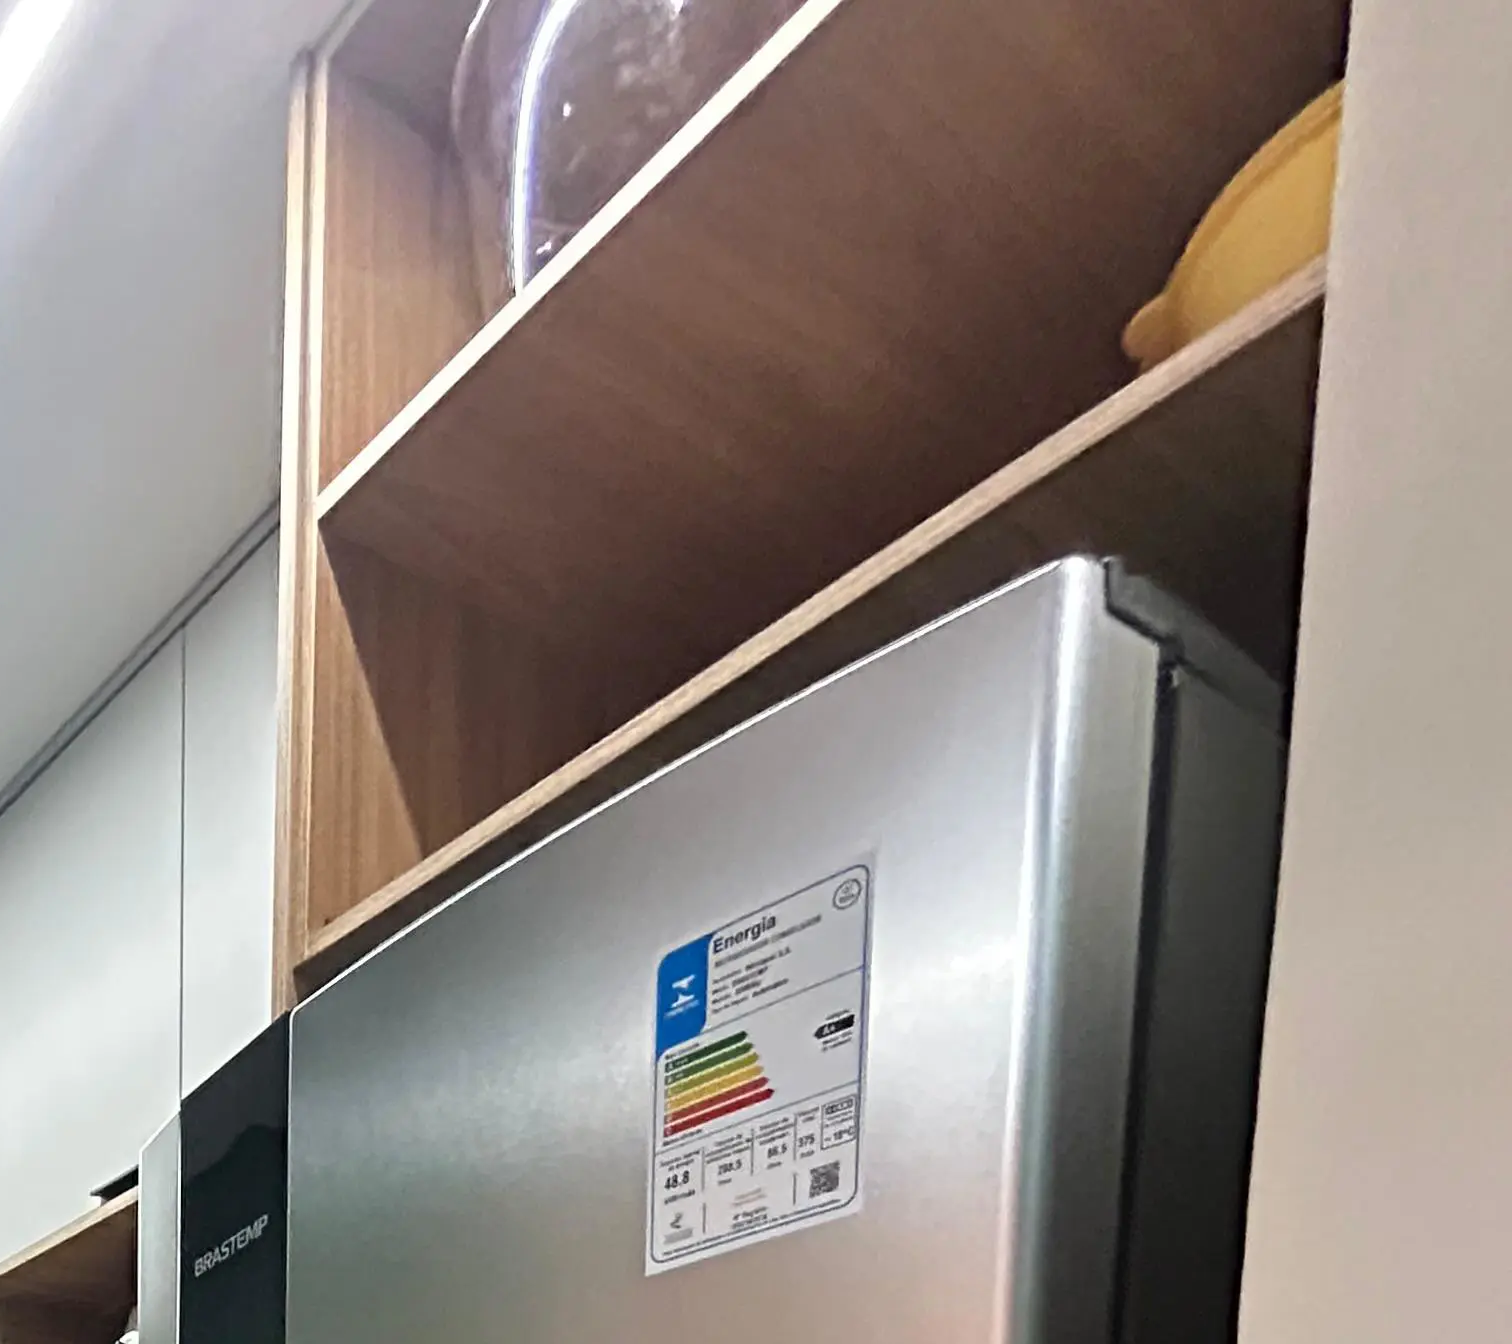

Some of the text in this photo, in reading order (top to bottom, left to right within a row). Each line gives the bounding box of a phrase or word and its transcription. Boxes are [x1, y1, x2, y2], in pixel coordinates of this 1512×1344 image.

[713, 915, 777, 954] Energia
[664, 1170, 691, 1190] 48.8
[193, 1213, 269, 1278] BRASTEMP
